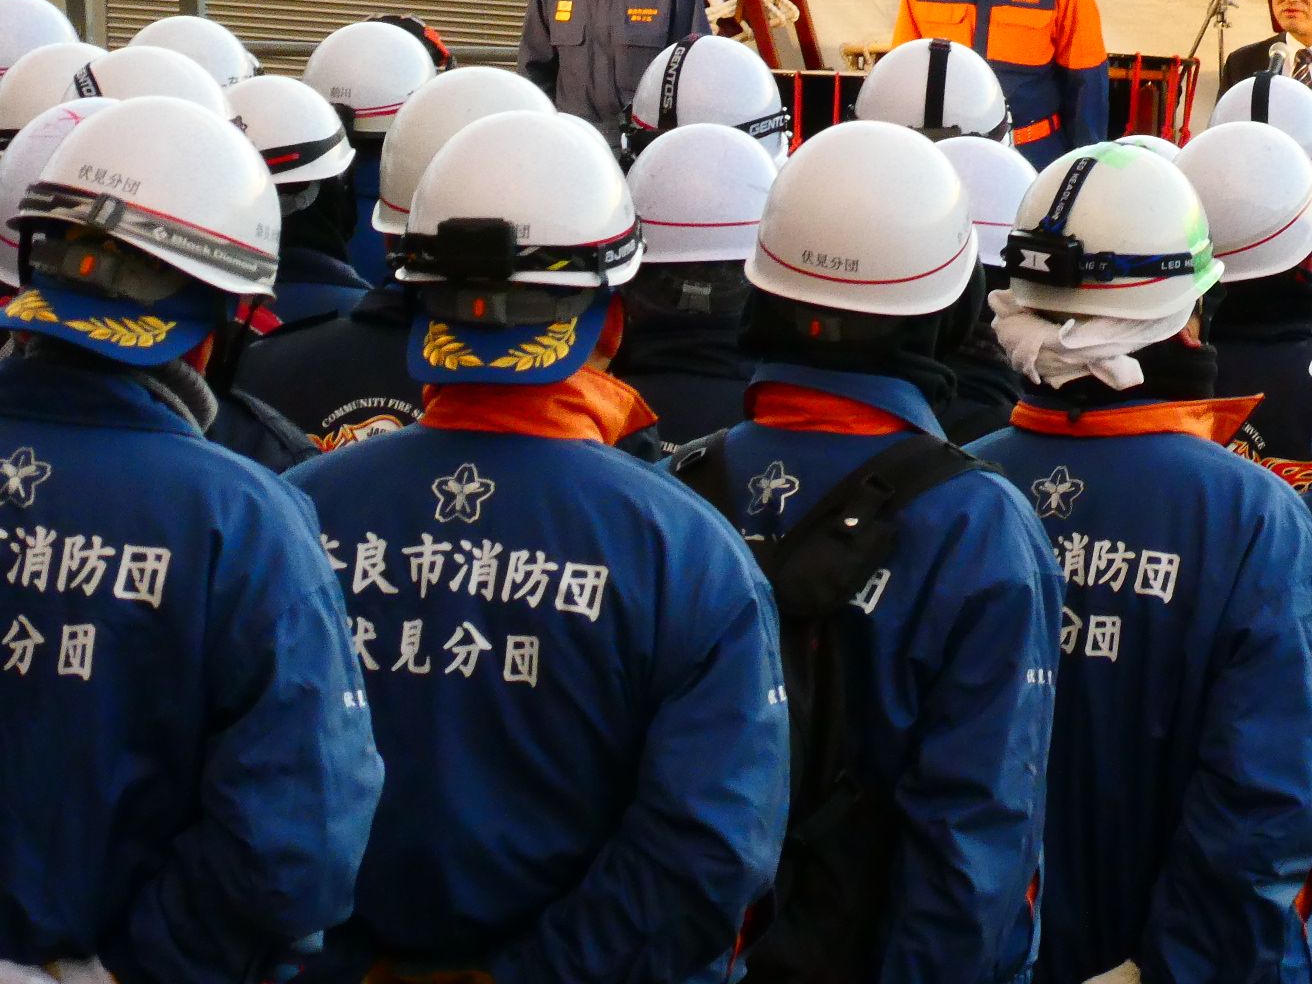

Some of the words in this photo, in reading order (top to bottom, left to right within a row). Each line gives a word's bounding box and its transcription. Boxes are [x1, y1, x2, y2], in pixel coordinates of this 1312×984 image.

[663, 46, 686, 110] GENTOS
[801, 249, 859, 273] 伏見分団
[322, 397, 386, 428] COMMUNITY
[387, 398, 412, 414] FIRE
[2, 614, 96, 681] 分団
